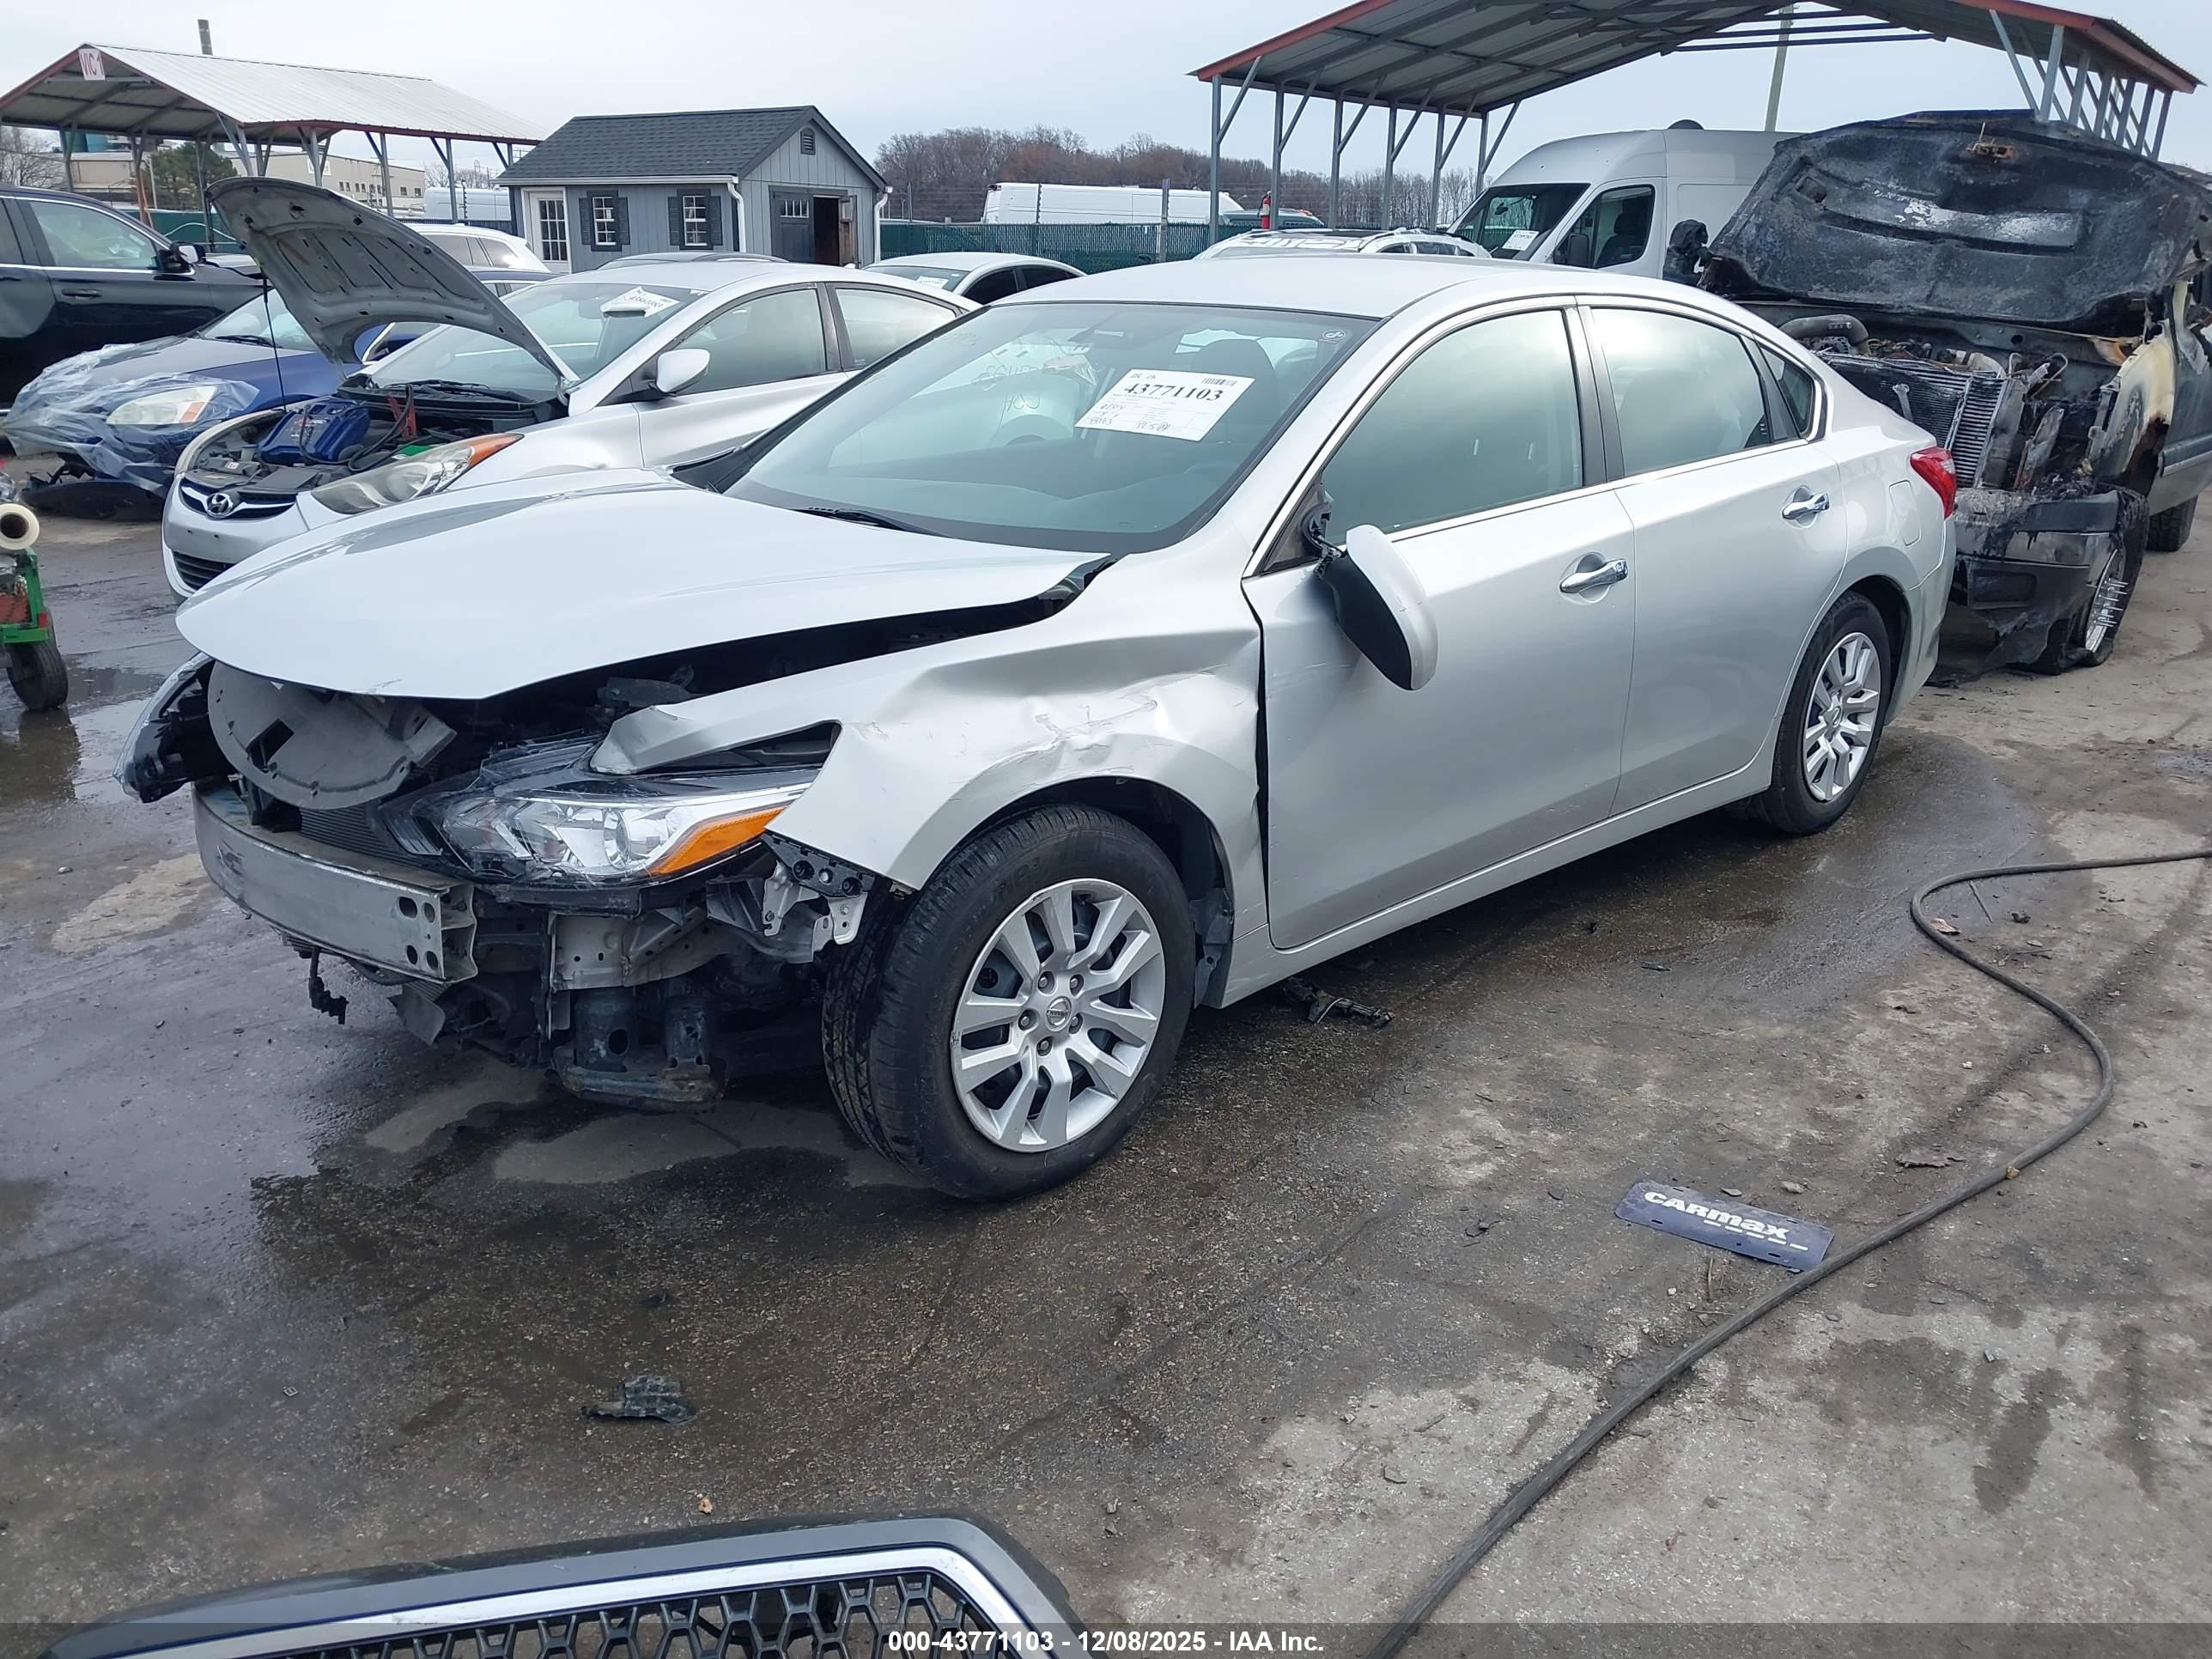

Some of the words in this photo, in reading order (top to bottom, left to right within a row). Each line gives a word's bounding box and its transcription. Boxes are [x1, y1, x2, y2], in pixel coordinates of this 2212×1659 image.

[79, 52, 96, 76] VIC
[97, 54, 104, 76] 1
[1124, 383, 1224, 401] 43771103
